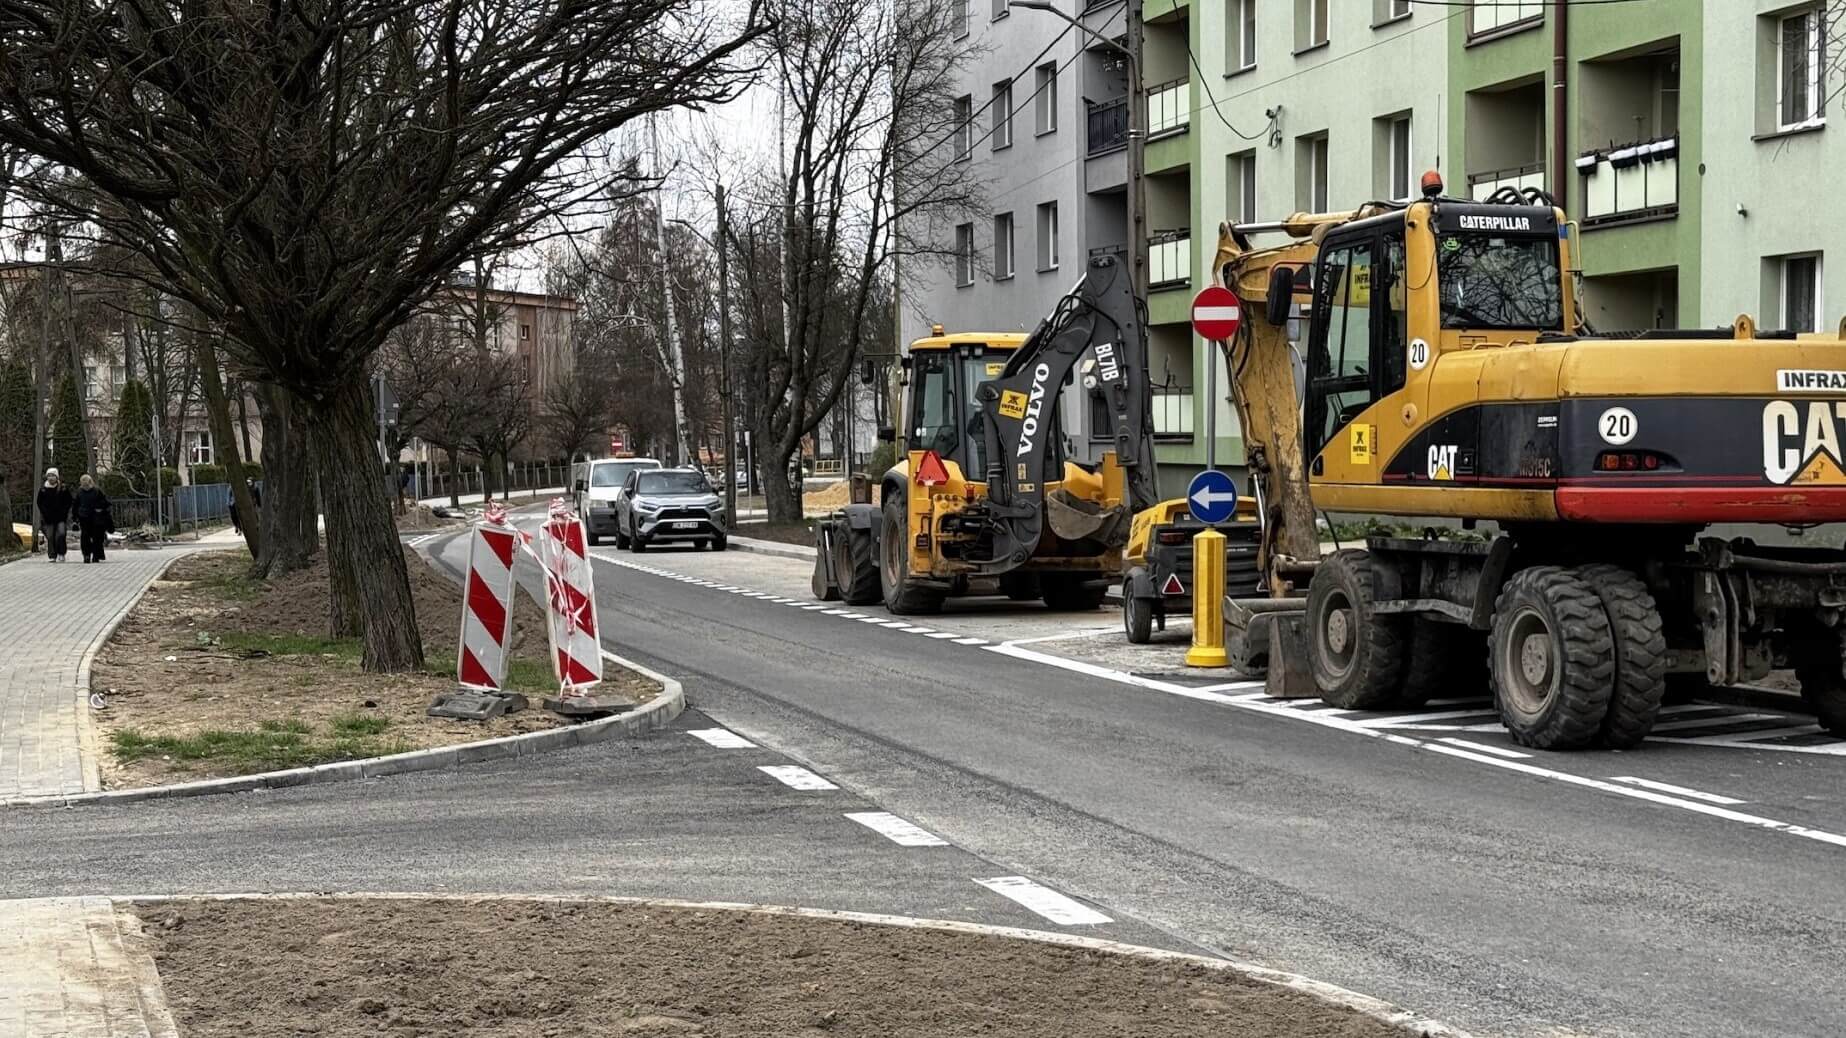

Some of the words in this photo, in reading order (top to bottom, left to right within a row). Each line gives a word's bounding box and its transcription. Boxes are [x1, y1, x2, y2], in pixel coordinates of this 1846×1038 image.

[1459, 215, 1530, 230] CATERPILLAR
[1094, 342, 1120, 381] BL71B
[1412, 343, 1425, 363] 20
[1017, 363, 1050, 457] VOLVO
[1606, 415, 1630, 437] 20
[1763, 400, 1846, 485] CA
[1428, 444, 1458, 480] CAT
